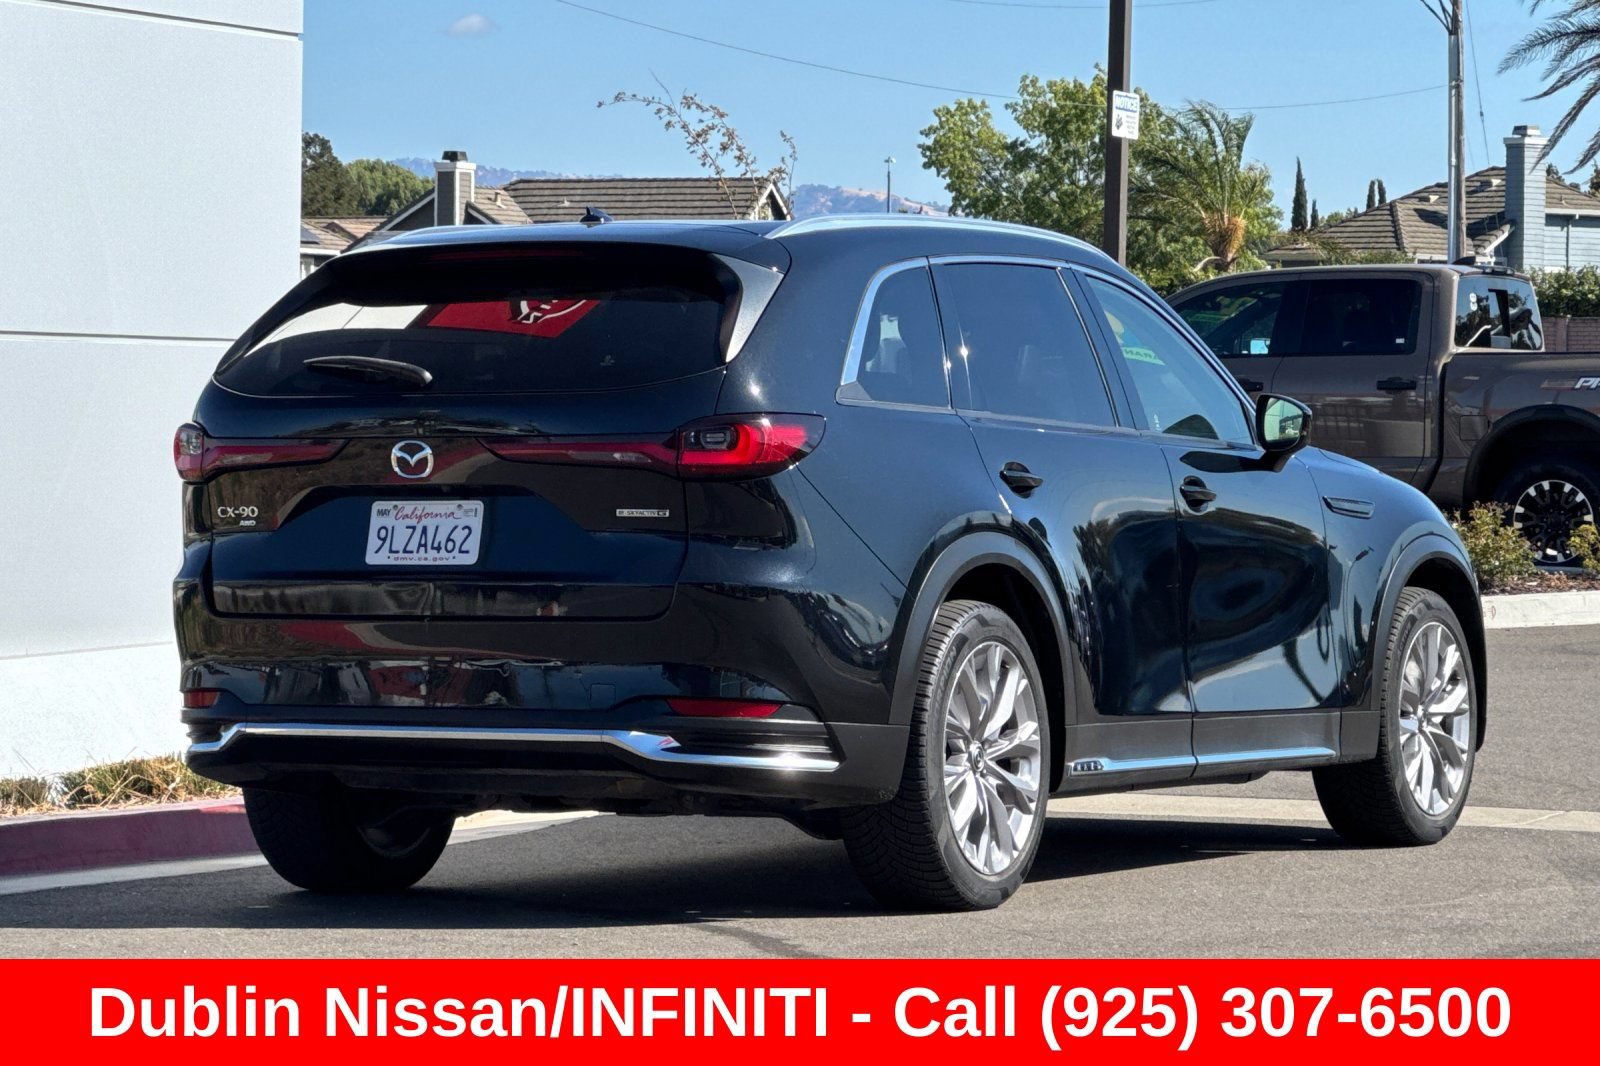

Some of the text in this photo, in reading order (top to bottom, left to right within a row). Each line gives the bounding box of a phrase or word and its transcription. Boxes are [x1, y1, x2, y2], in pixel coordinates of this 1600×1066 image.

[1115, 96, 1138, 111] NOTICE
[217, 506, 259, 518] CX-90
[376, 509, 391, 517] MAY
[394, 505, 462, 524] California
[374, 525, 473, 554] 9LZA462
